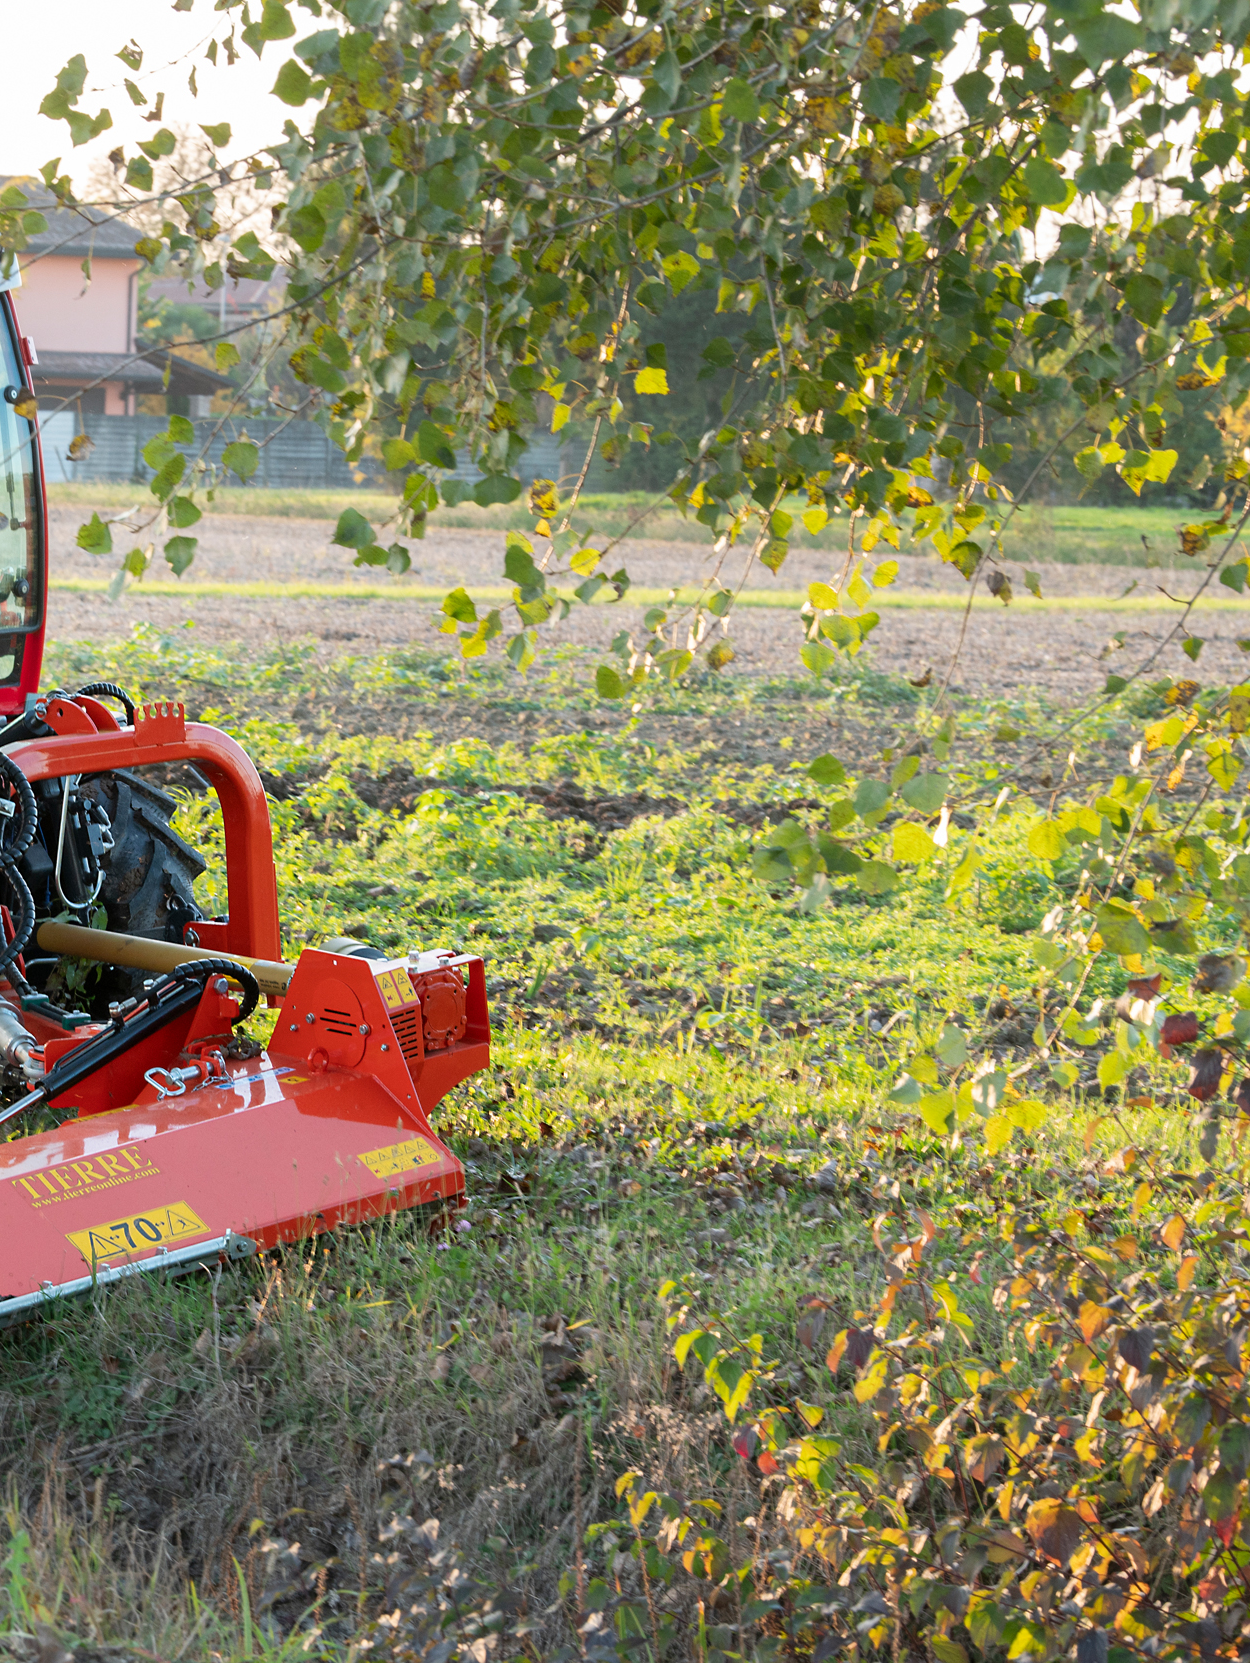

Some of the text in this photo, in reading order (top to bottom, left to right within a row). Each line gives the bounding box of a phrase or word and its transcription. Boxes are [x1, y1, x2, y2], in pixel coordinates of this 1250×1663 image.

[11, 1145, 153, 1200] TIERRE
[31, 1166, 161, 1209] www.tierreonline.com
[109, 1217, 163, 1249] 70
